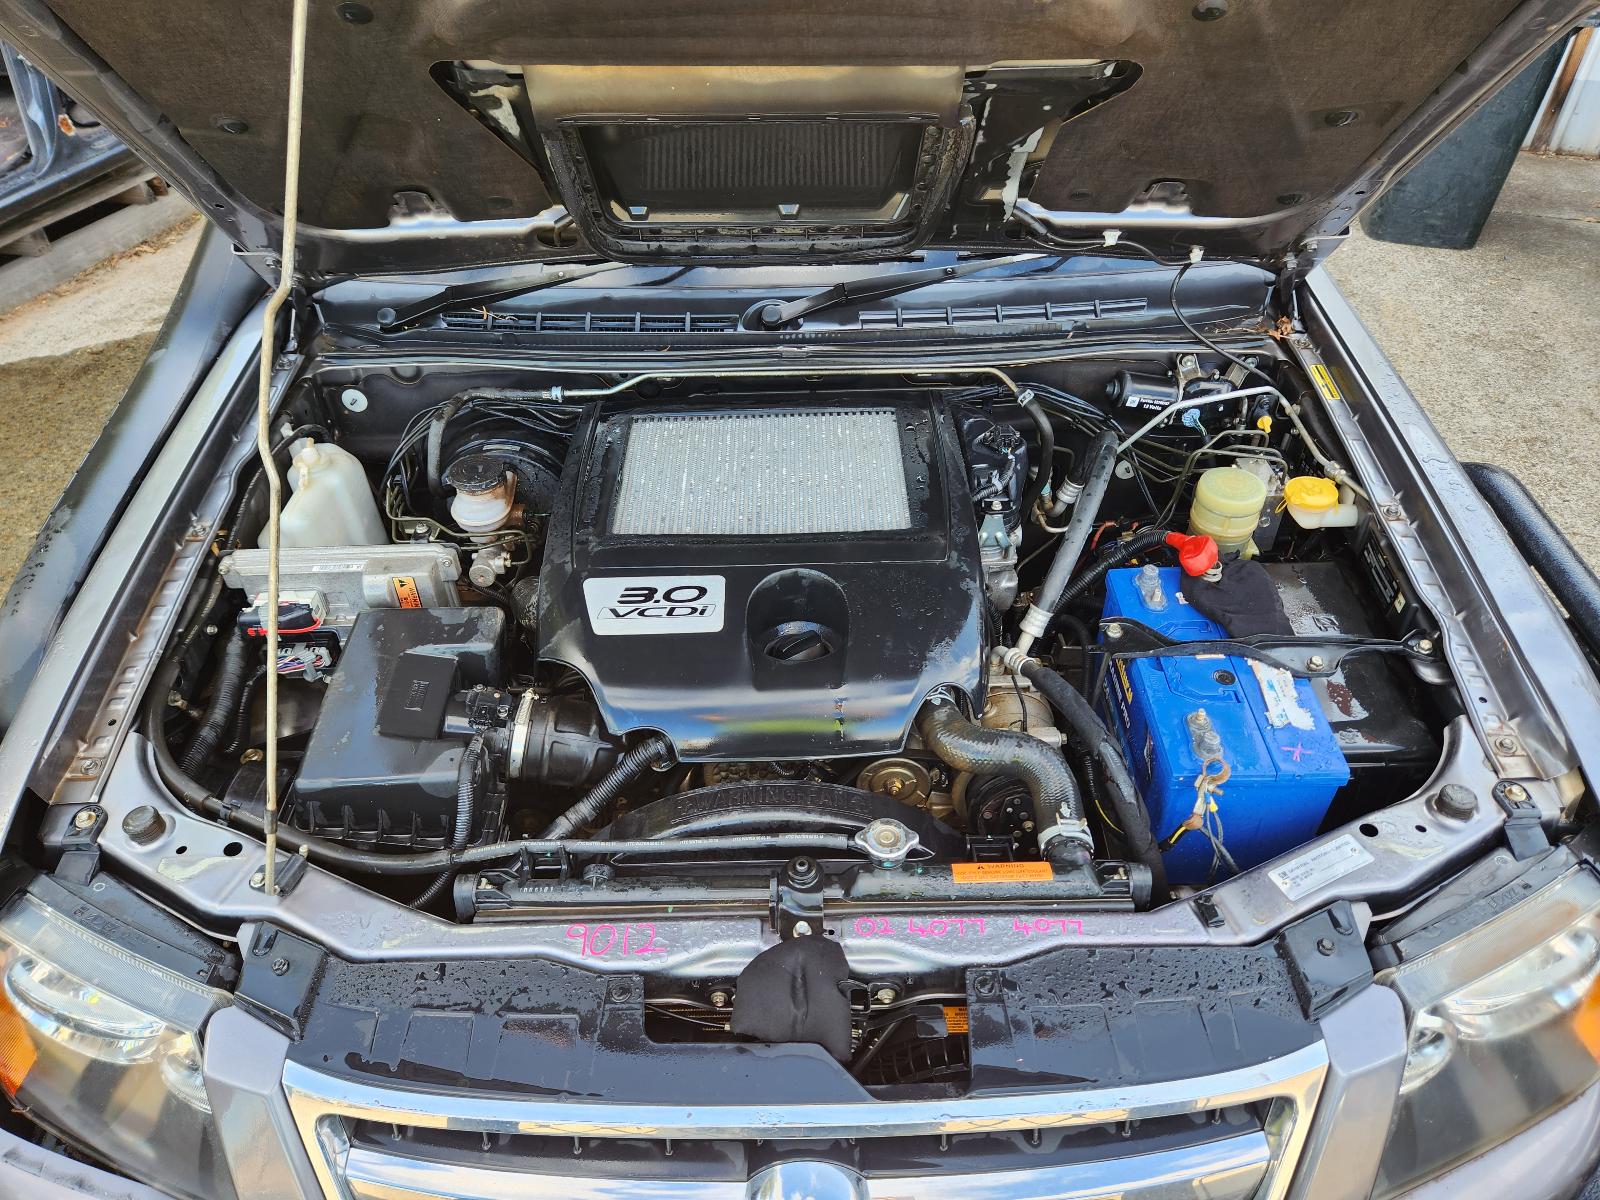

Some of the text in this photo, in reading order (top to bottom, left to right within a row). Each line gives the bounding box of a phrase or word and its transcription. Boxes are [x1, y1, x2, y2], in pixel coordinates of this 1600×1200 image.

[616, 585, 708, 604] 3.0
[608, 605, 709, 618] VCDi
[854, 916, 1084, 938] 02 4077 4077
[565, 923, 667, 958] 9012
